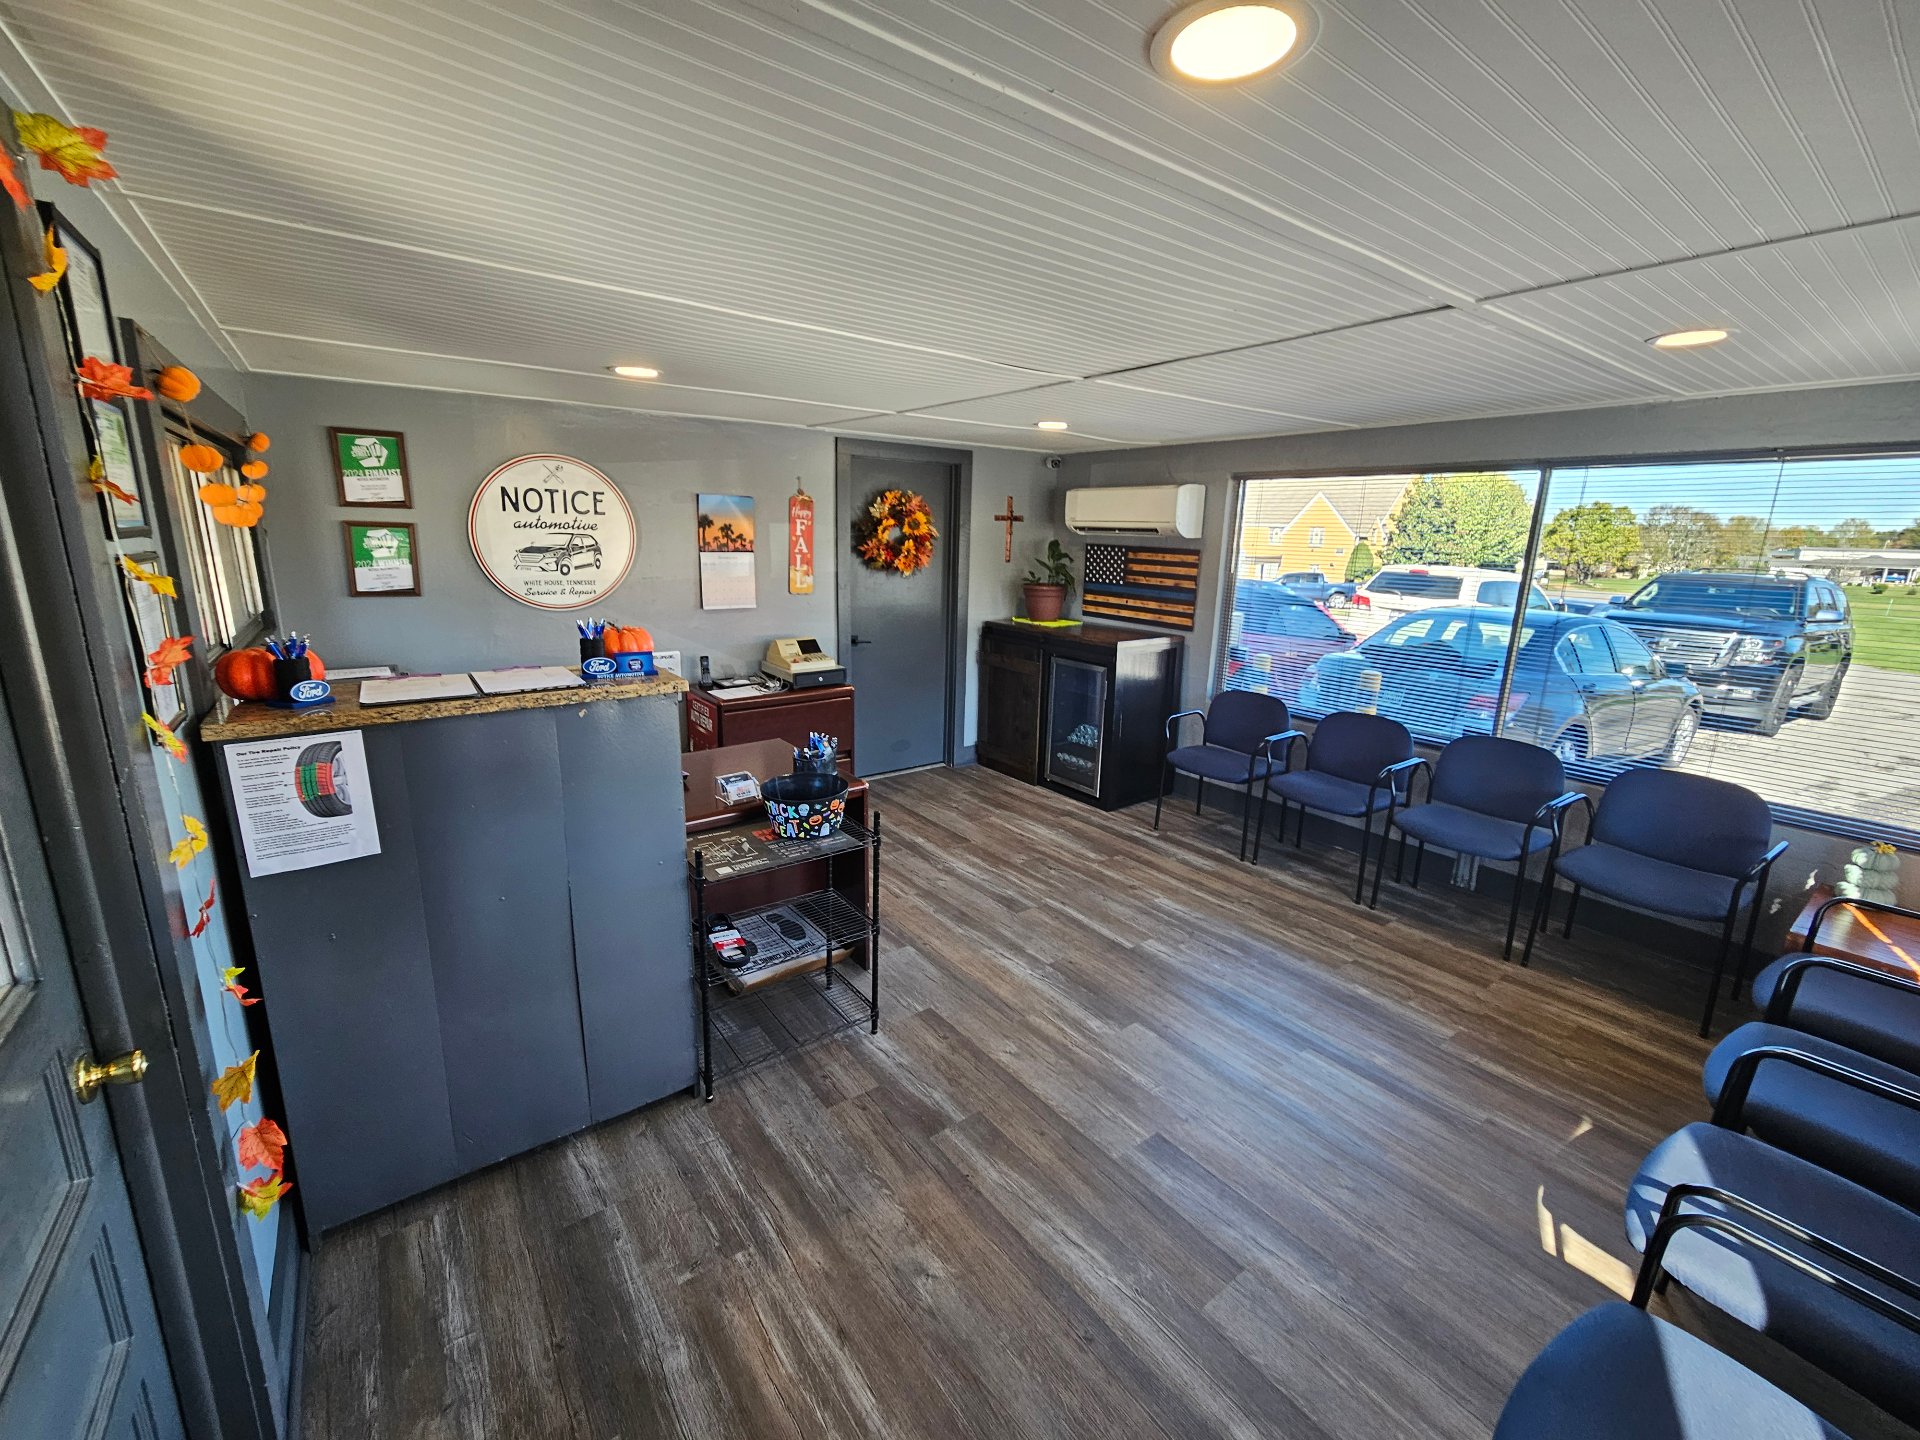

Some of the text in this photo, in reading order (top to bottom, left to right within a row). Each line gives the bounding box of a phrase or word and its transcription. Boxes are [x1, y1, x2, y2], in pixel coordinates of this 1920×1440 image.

[365, 468, 401, 477] FINALIST
[500, 486, 606, 516] NOTICE
[792, 505, 812, 519] Happy
[513, 515, 599, 531] automotive
[794, 519, 808, 588] FALL
[544, 579, 565, 587] HOUSE,
[524, 586, 598, 598] Service & Repair
[589, 659, 610, 672] Ford
[614, 671, 645, 679] AUTOMOTIVE
[298, 682, 324, 699] Ford
[764, 800, 800, 819] TRICK
[768, 814, 800, 838] TREAT
[775, 815, 787, 827] OR
